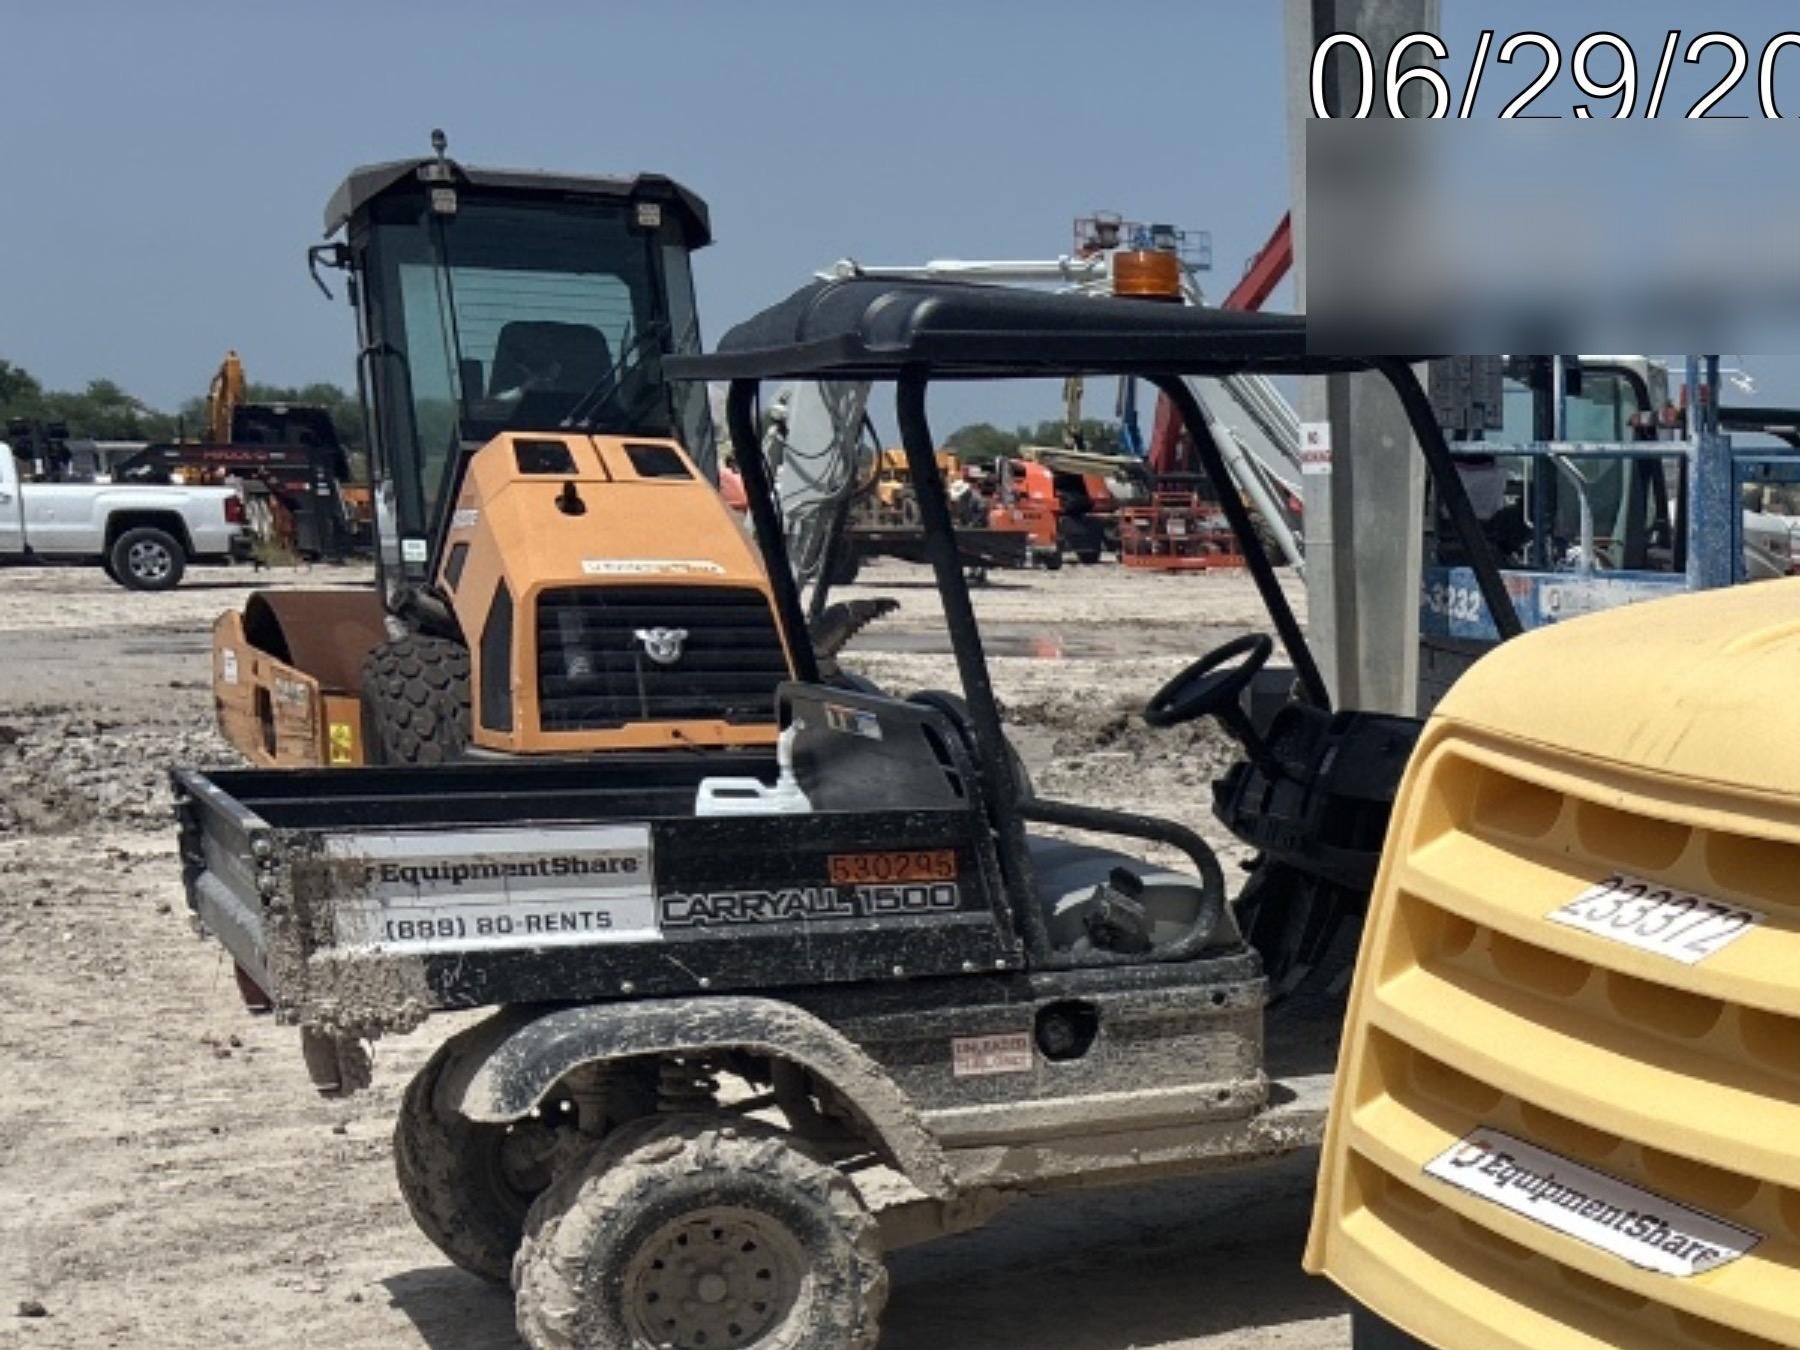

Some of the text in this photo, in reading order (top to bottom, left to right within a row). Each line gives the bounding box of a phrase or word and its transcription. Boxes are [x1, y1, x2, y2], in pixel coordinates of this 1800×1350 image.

[380, 856, 639, 885] EquipmentShare
[831, 854, 953, 881] 530295
[660, 882, 961, 926] CARRYALL 1500
[1559, 875, 1753, 952] 233372
[385, 910, 613, 941] (888) 80-RENTS
[1477, 1149, 1720, 1263] EquipmentShare
